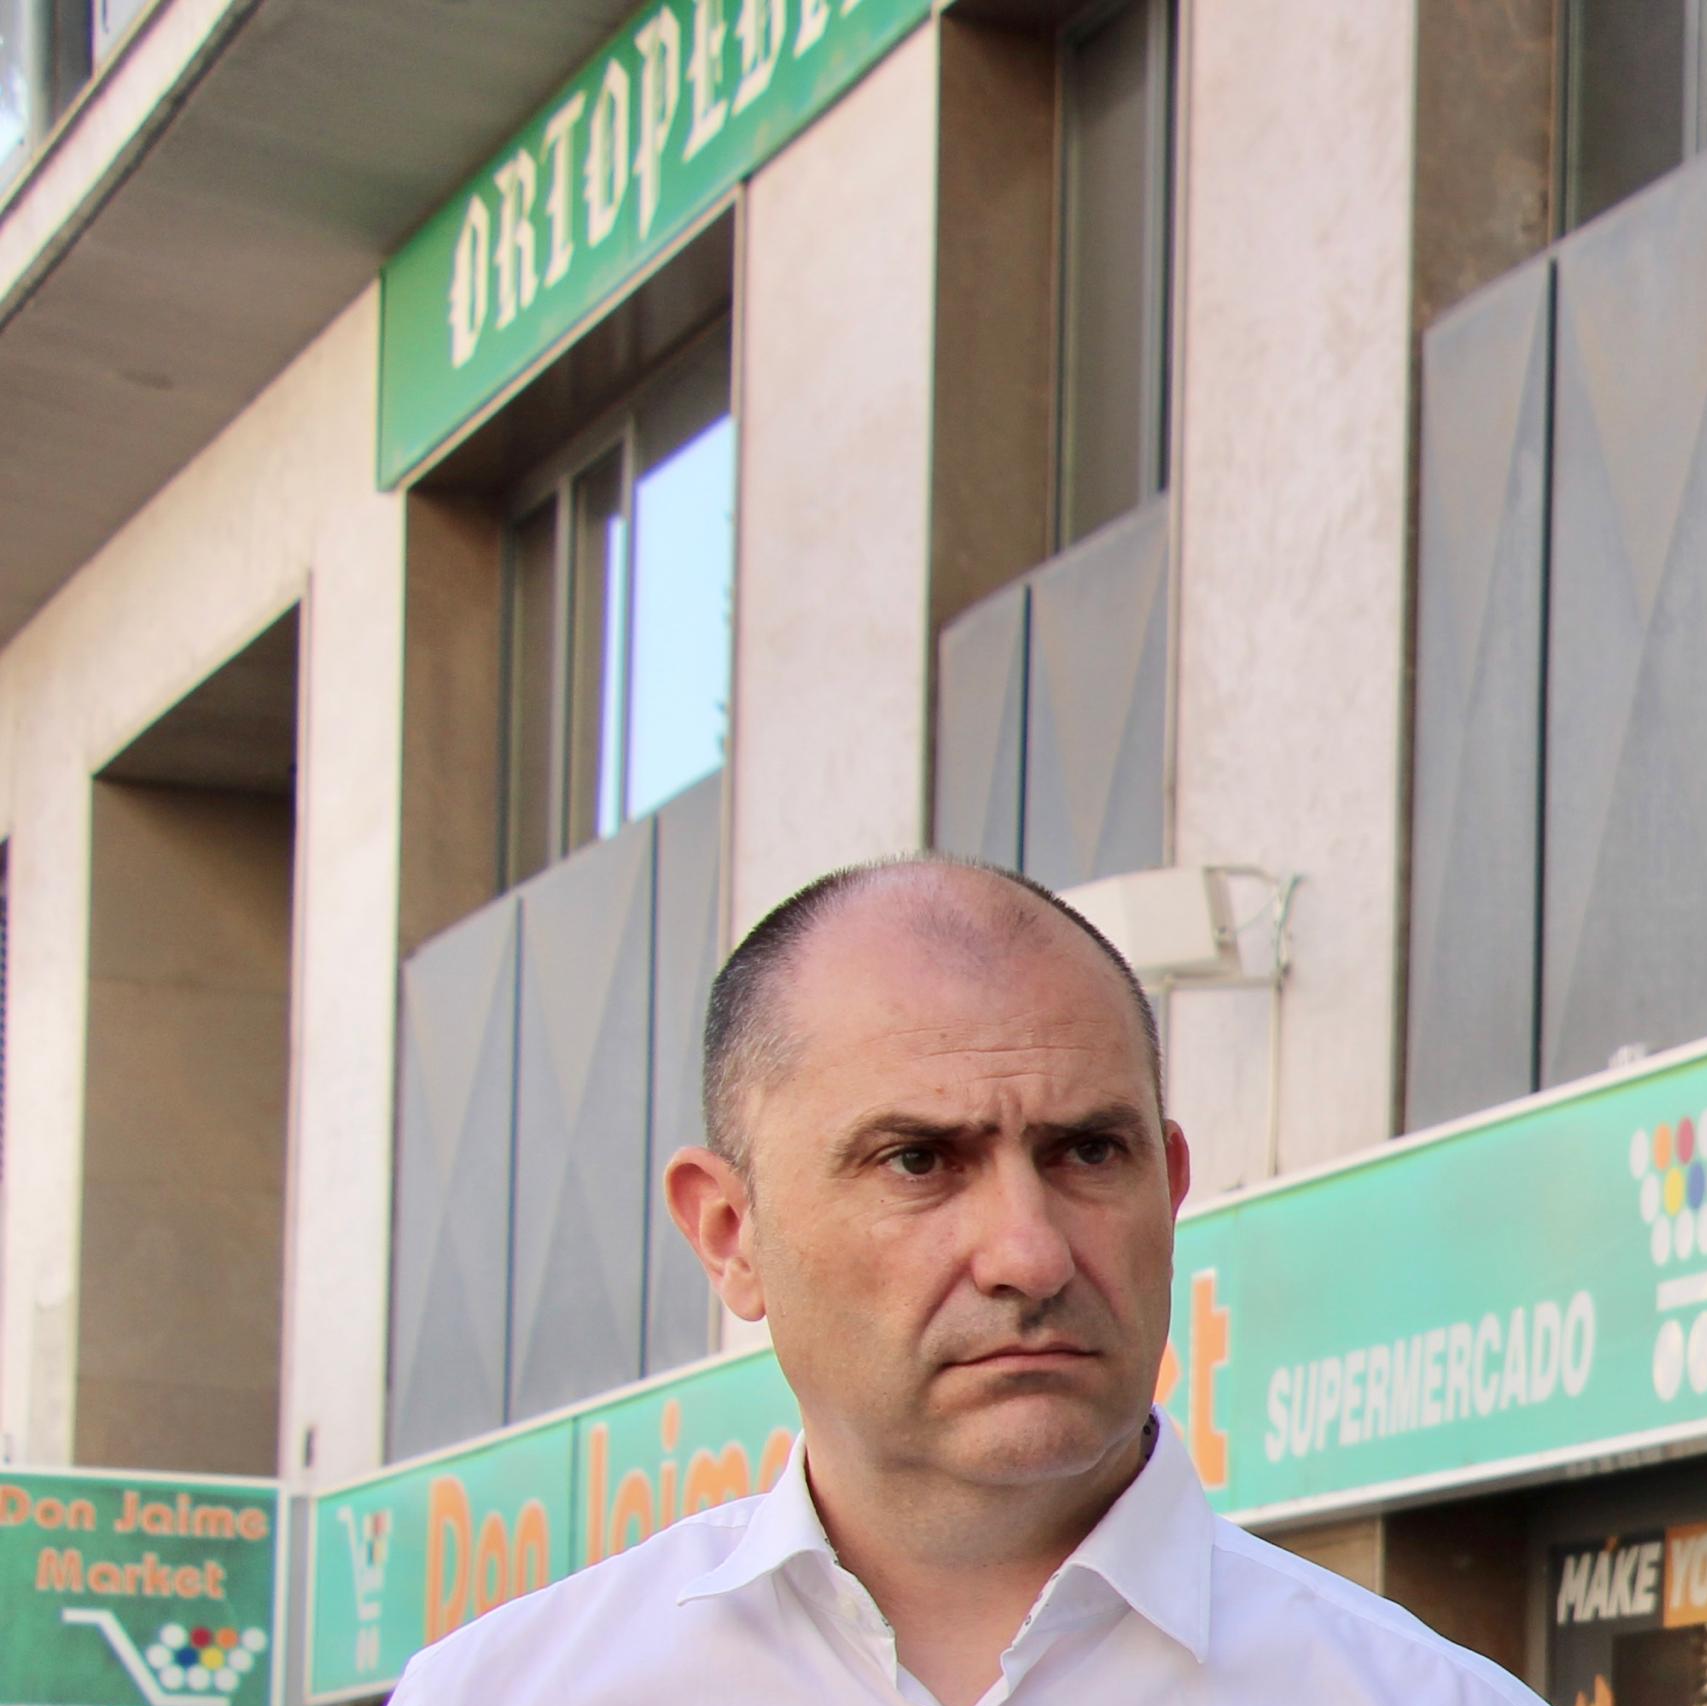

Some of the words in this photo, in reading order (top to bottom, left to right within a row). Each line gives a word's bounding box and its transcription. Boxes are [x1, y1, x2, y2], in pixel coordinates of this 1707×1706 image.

[448, 0, 864, 368] ORTOPED
[1264, 1290, 1596, 1463] SUPERMERCADO
[0, 1484, 96, 1531] Don
[114, 1489, 268, 1541] Jaime
[35, 1546, 226, 1600] Market
[1556, 1541, 1663, 1626] MAKE
